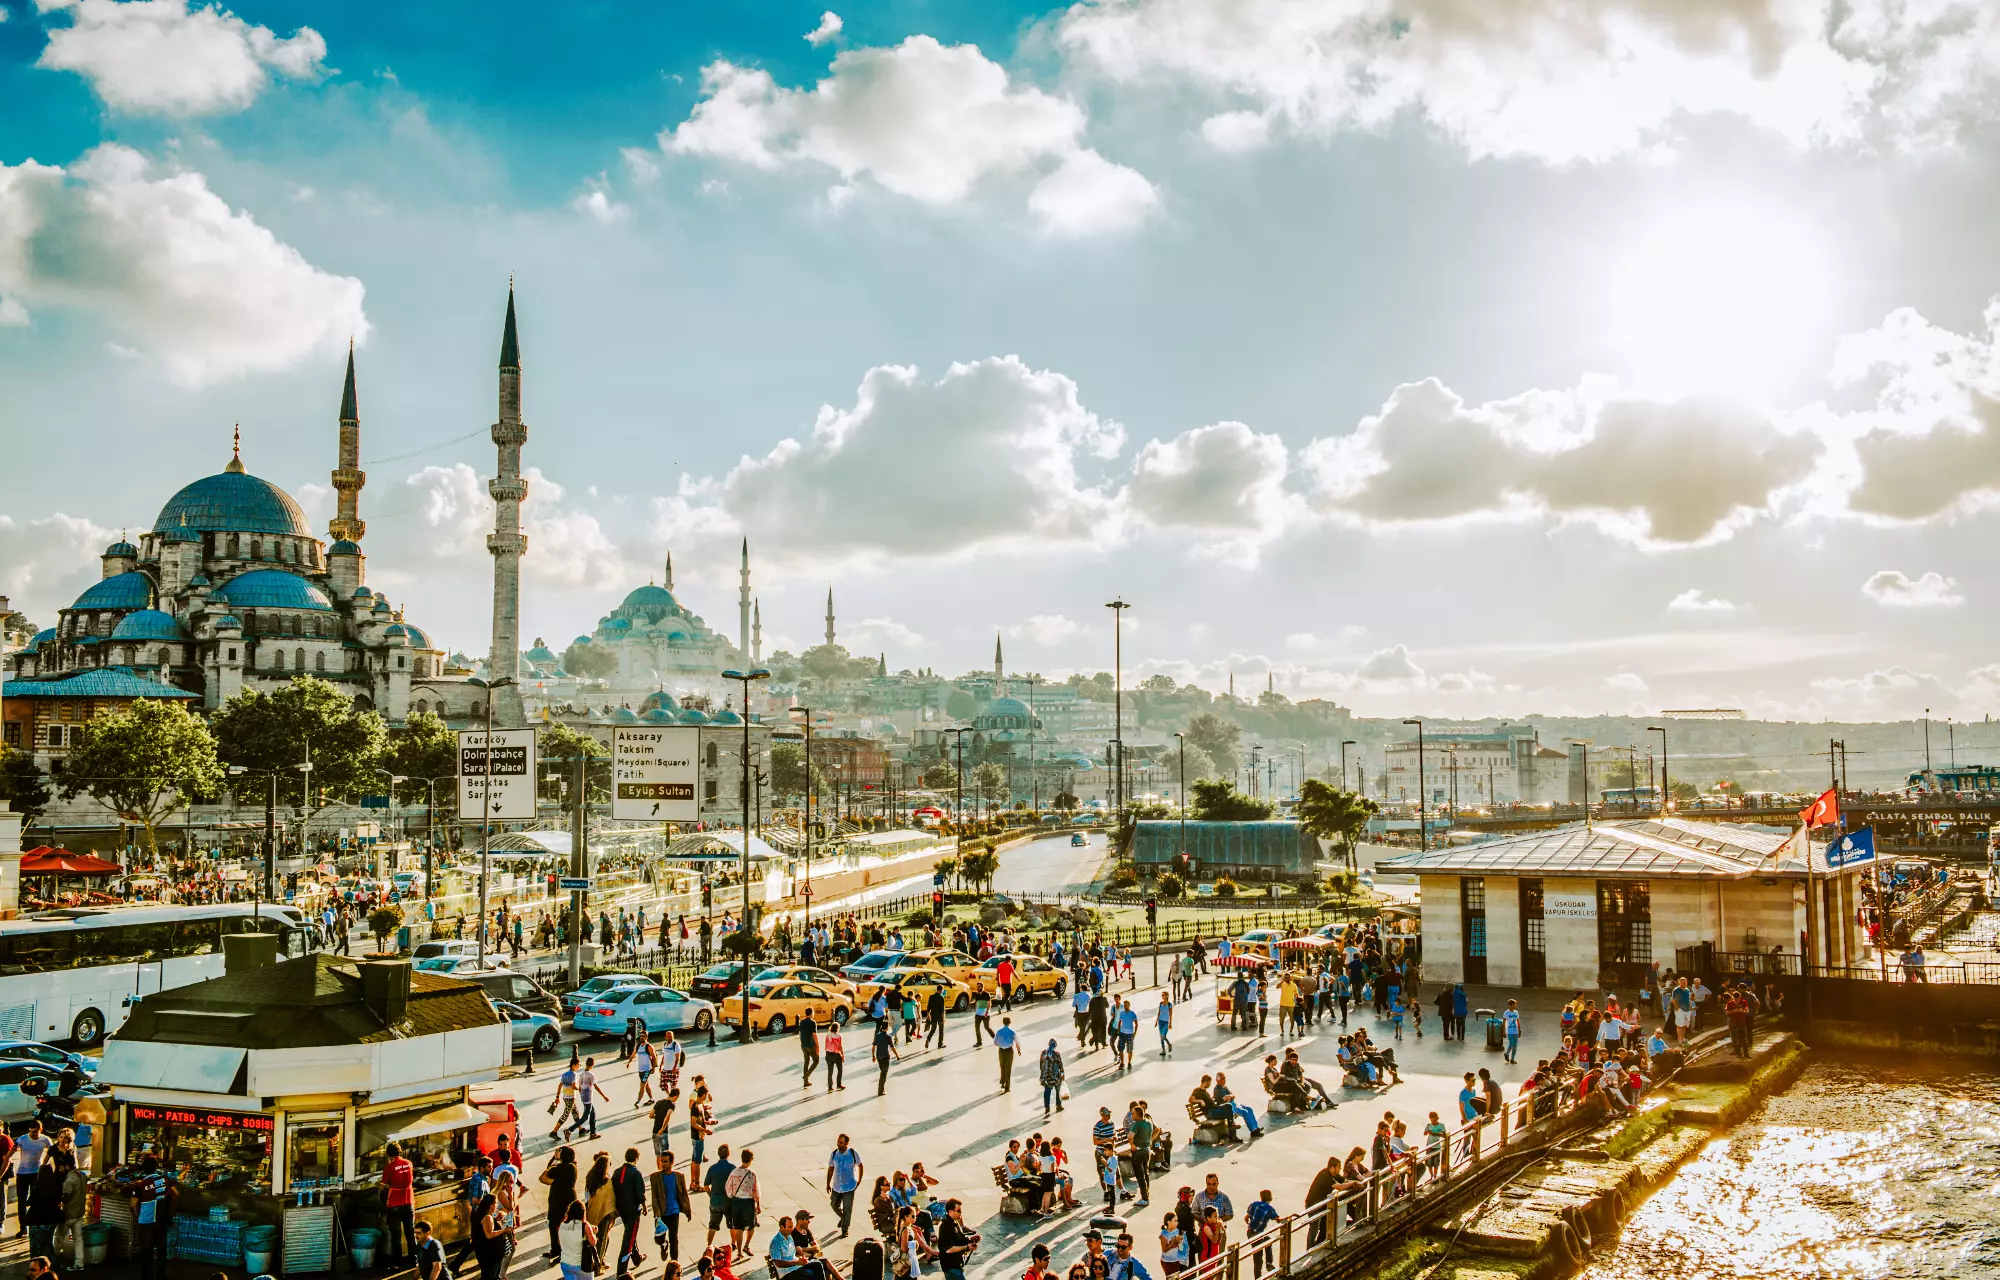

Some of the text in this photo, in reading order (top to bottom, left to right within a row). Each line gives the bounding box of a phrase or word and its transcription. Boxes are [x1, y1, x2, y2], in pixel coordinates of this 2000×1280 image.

[467, 736, 506, 745] Karaköy
[618, 732, 662, 743] Aksaray
[618, 744, 654, 754] Taksim
[463, 749, 524, 760] Dolmabahçe
[493, 762, 524, 773] (Palace)
[654, 758, 690, 768] (Square)
[617, 770, 644, 779] Fatih
[468, 790, 502, 801] Saryer
[628, 785, 691, 797] Eyüp Sultan
[1866, 812, 1991, 821] GALATA SEMBOL BALIK
[1554, 899, 1586, 908] ÜSKÜDAR
[134, 1107, 155, 1120] WICH
[166, 1111, 195, 1124] PATSO
[207, 1115, 233, 1127] CHIPS
